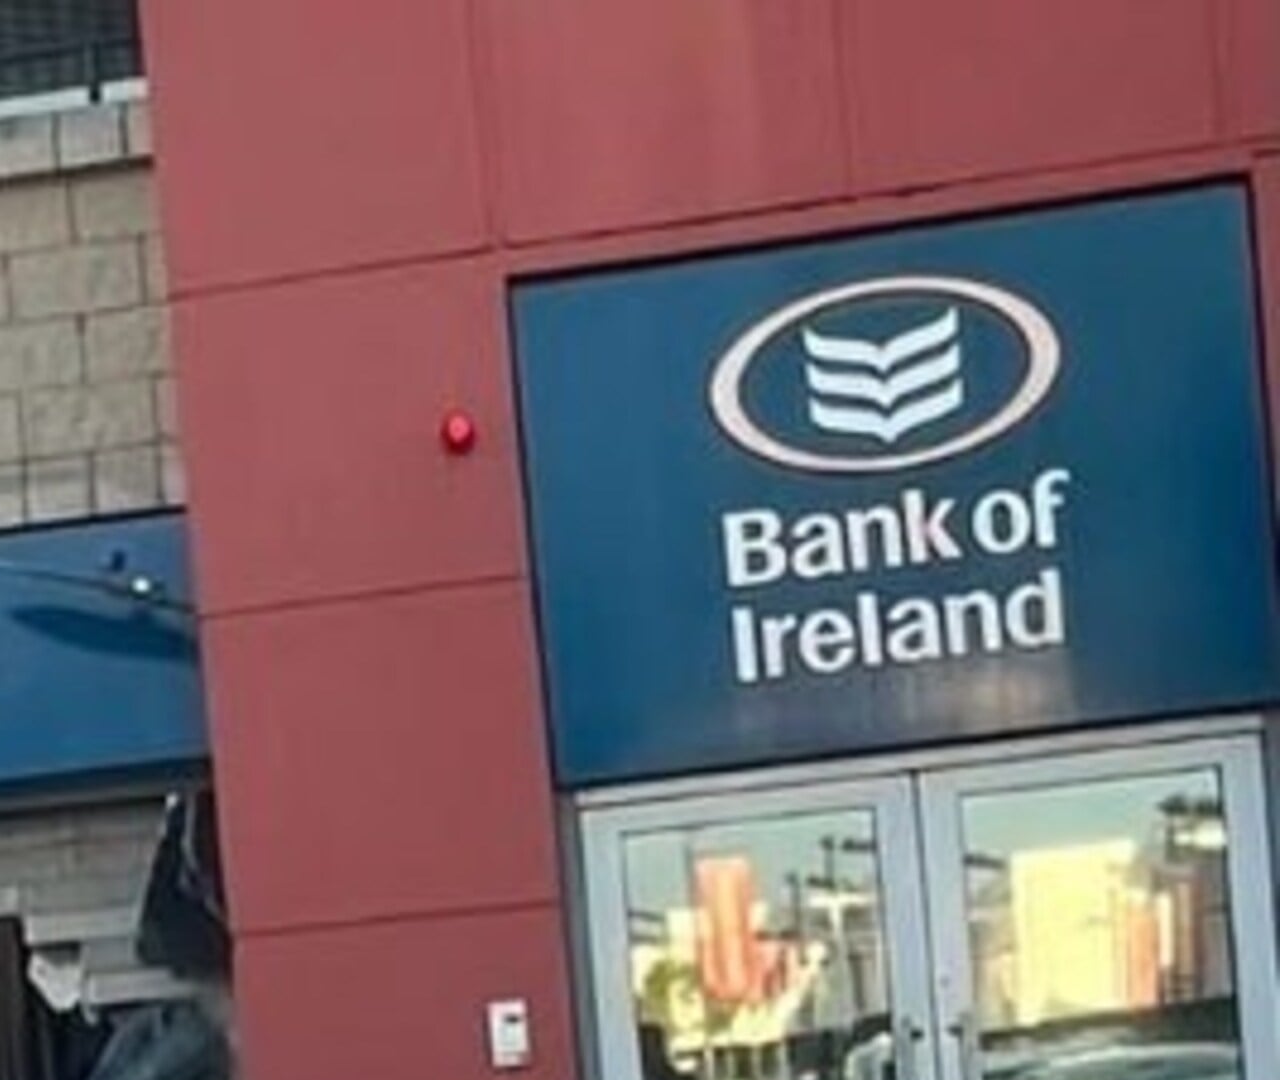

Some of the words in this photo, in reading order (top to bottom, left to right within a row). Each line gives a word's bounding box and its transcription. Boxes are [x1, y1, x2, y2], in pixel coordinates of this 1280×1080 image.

[722, 489, 963, 588] Bank
[972, 469, 1071, 555] of
[731, 568, 1066, 684] Ireland
